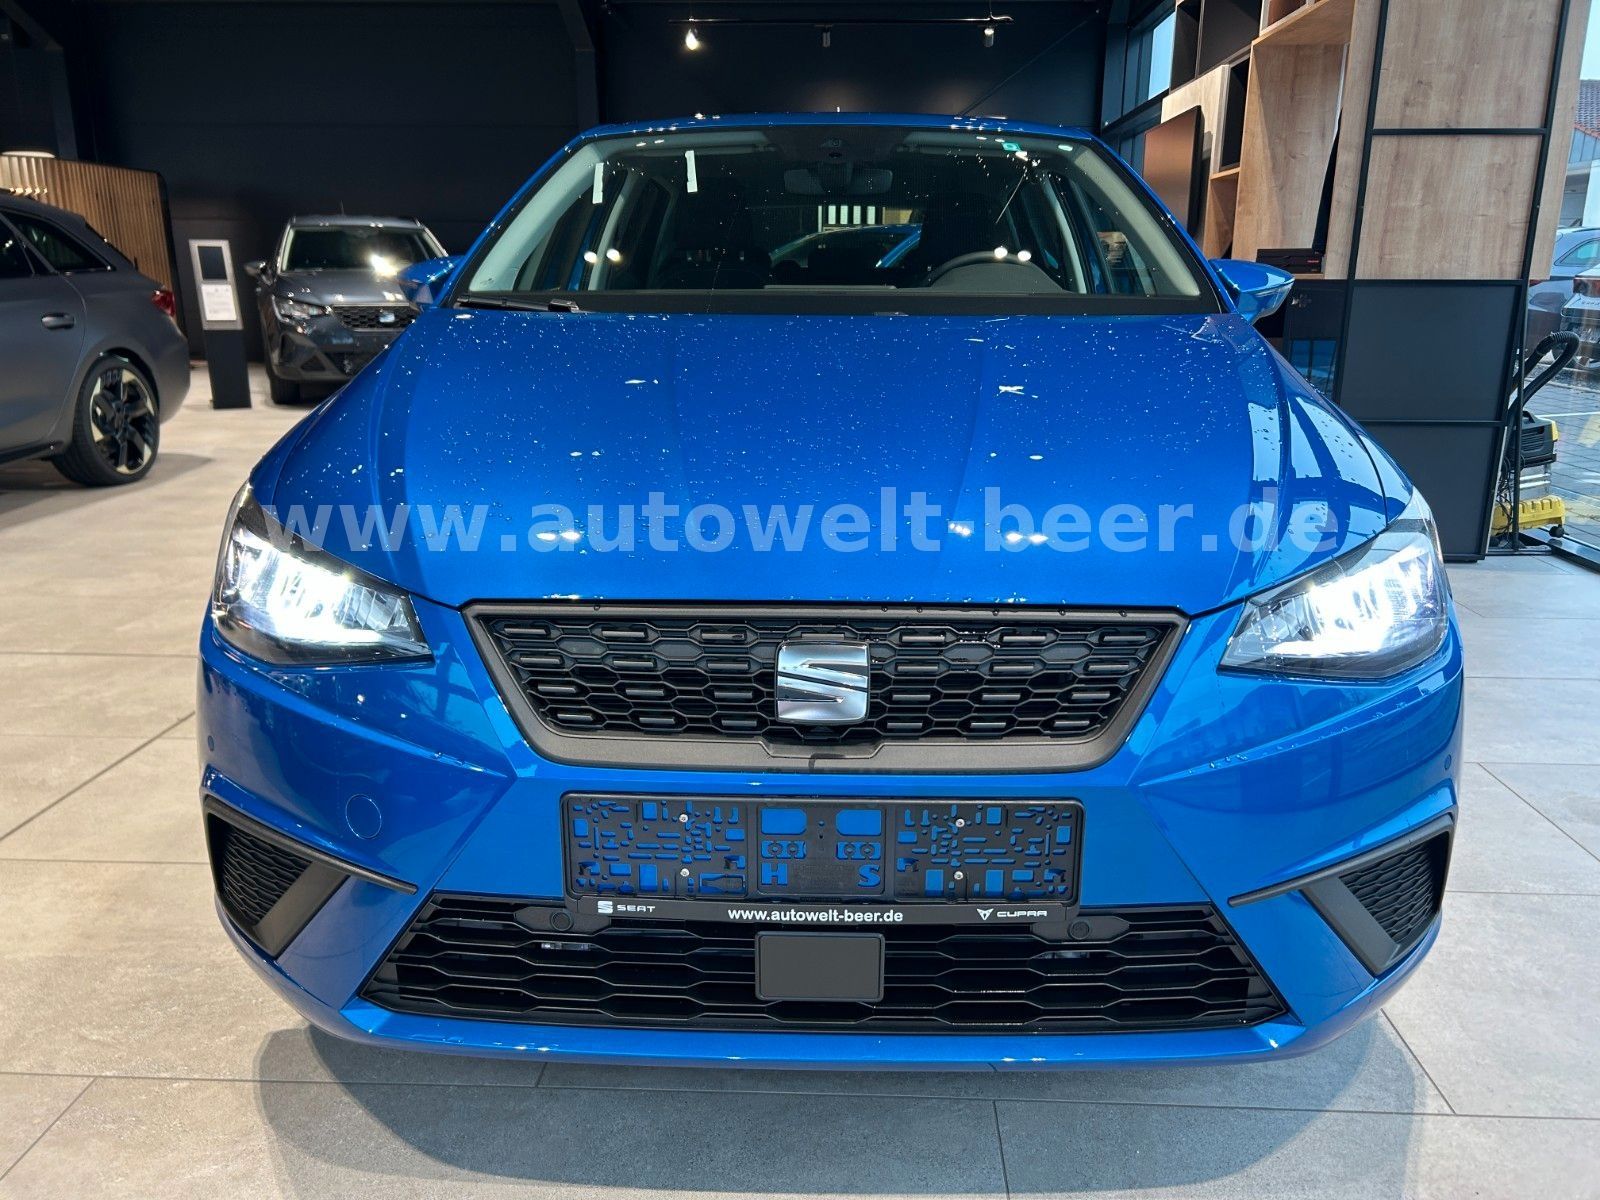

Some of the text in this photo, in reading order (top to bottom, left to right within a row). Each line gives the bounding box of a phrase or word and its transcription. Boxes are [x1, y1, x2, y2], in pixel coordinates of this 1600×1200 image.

[616, 904, 656, 913] SEAT
[727, 908, 904, 923] www.autowelt-beer.de
[996, 910, 1048, 918] CUPRA
